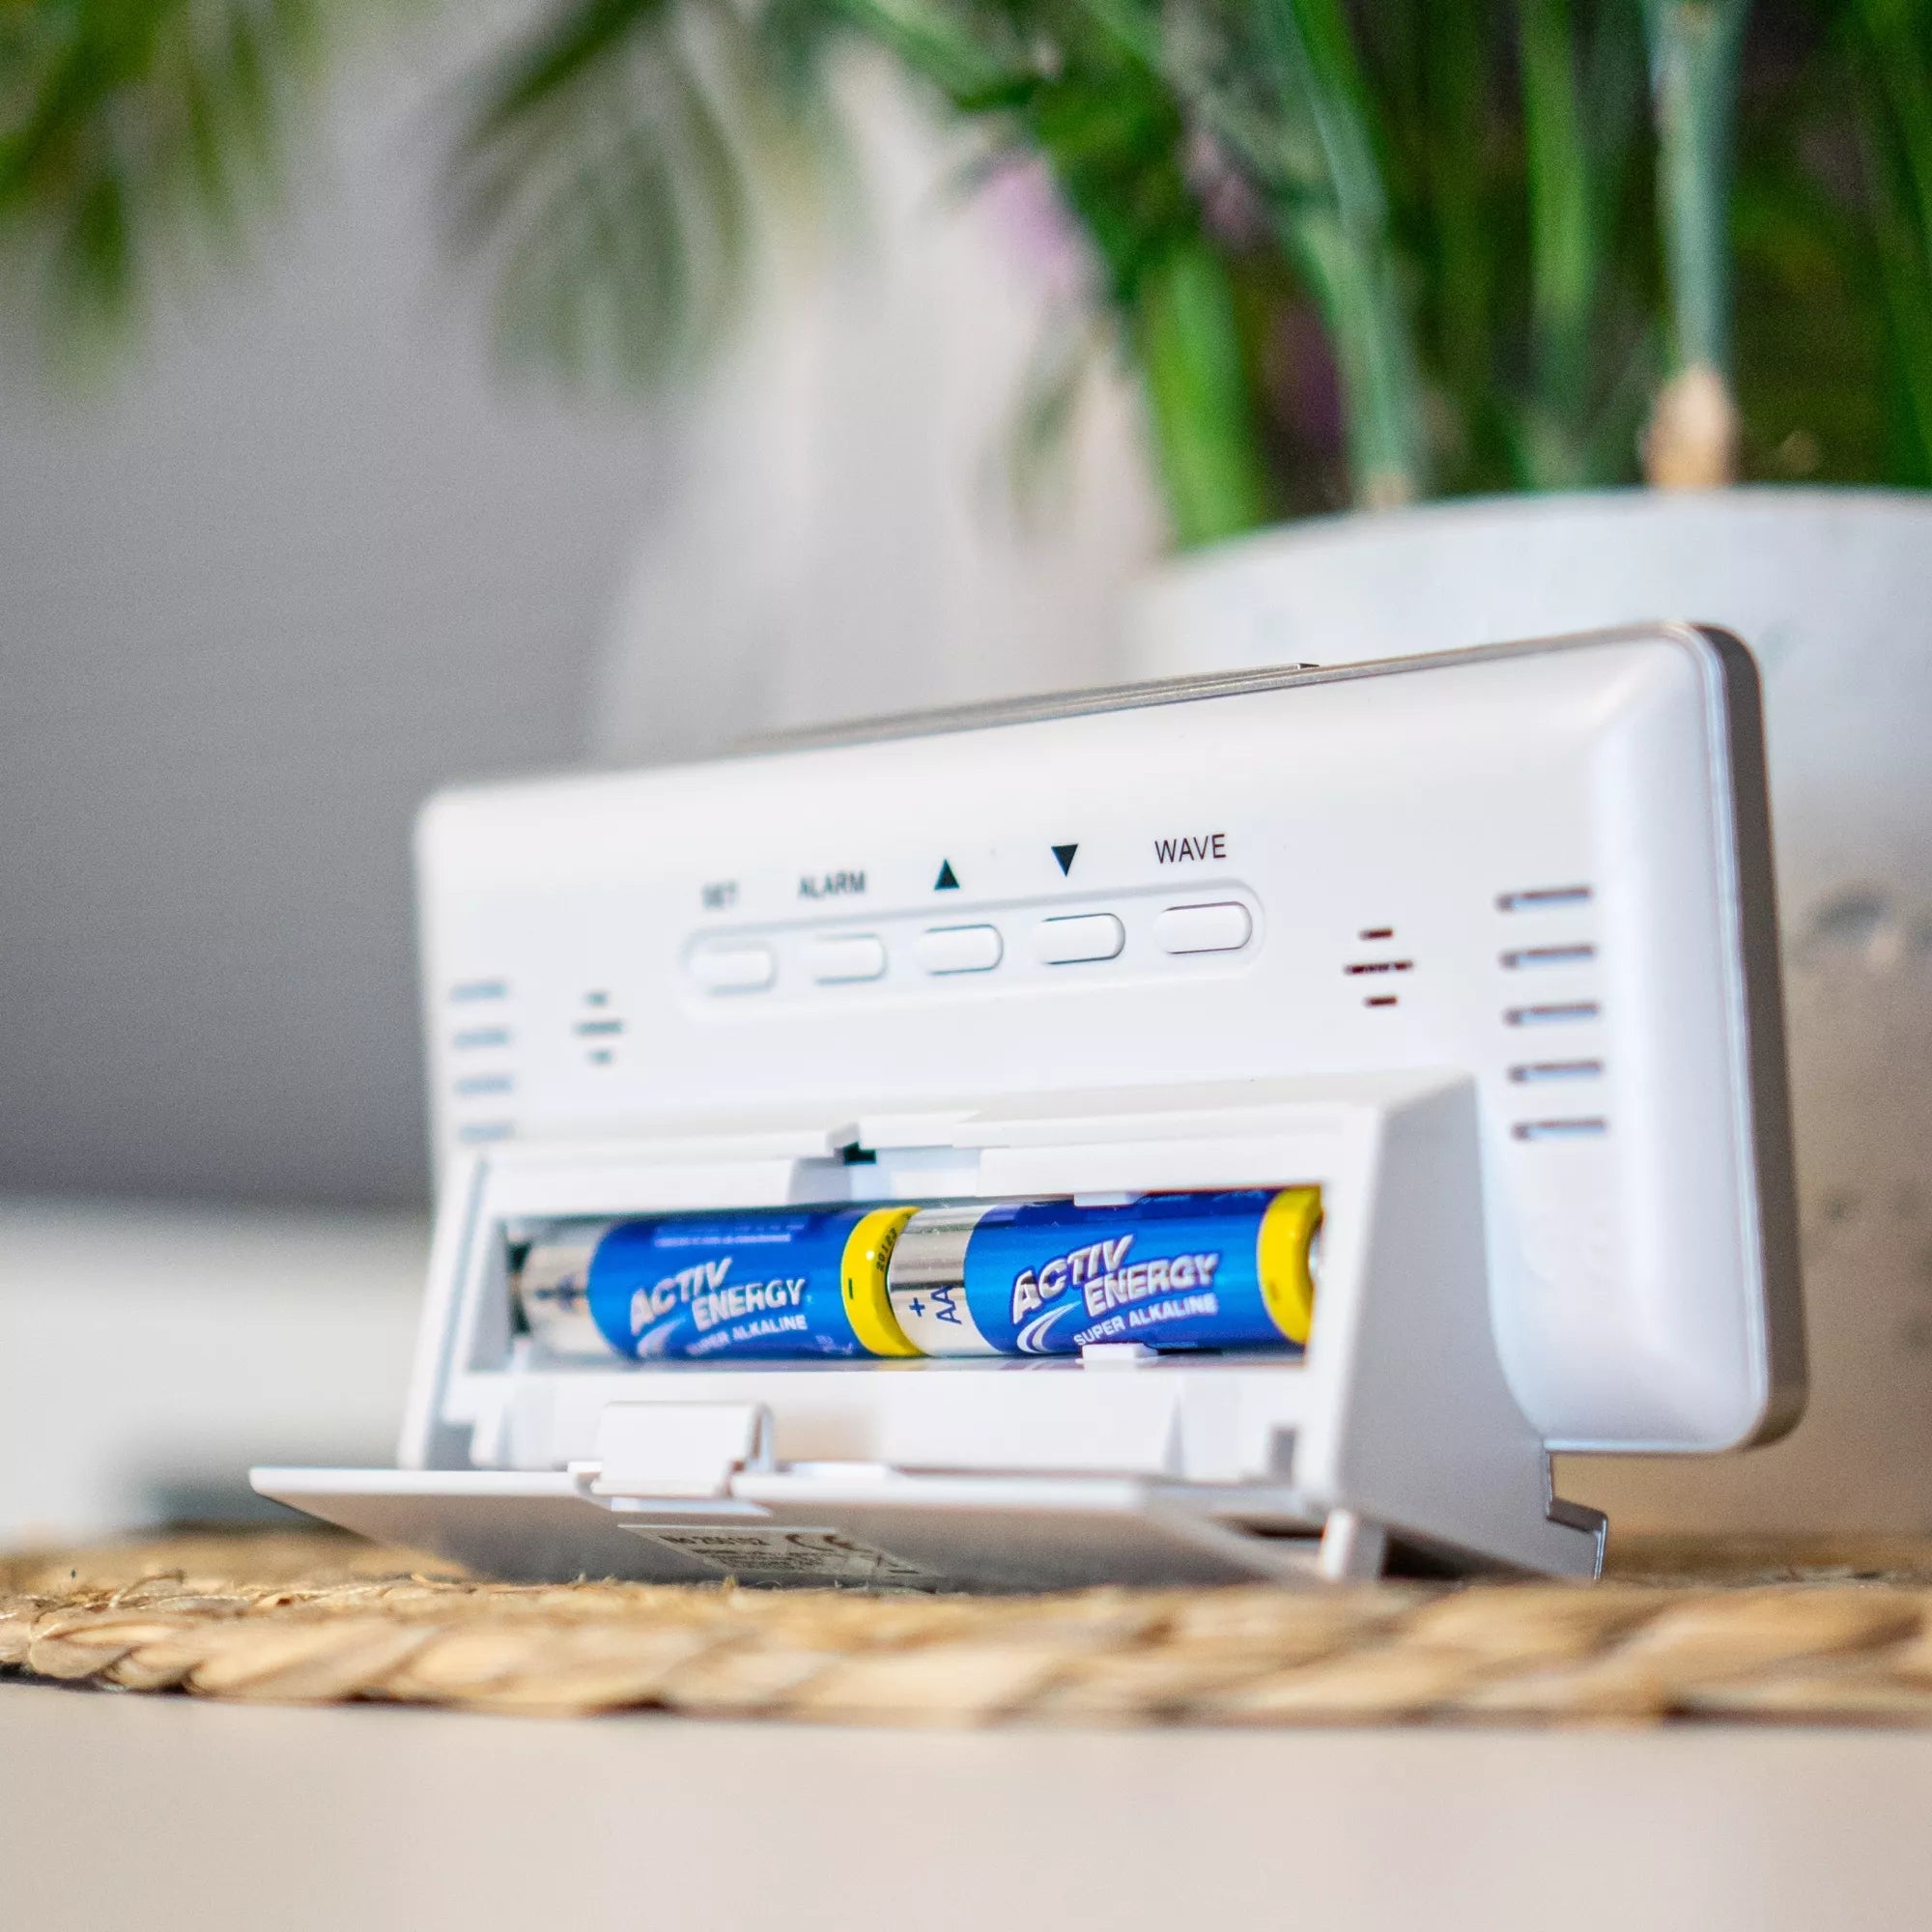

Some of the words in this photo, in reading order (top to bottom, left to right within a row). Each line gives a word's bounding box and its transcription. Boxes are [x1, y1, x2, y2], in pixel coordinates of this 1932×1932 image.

[1154, 834, 1227, 864] WAVE
[798, 869, 866, 899] ALARM
[630, 1257, 731, 1336] ACTIV
[692, 1279, 806, 1332] ENERGY
[930, 1284, 962, 1324] AA
[1012, 1234, 1134, 1324] ACTIV
[1084, 1253, 1219, 1318] ENERGY
[732, 1314, 808, 1342] ALKALINE
[1073, 1315, 1125, 1346] SUPER
[1128, 1293, 1219, 1327] ALKALINE
